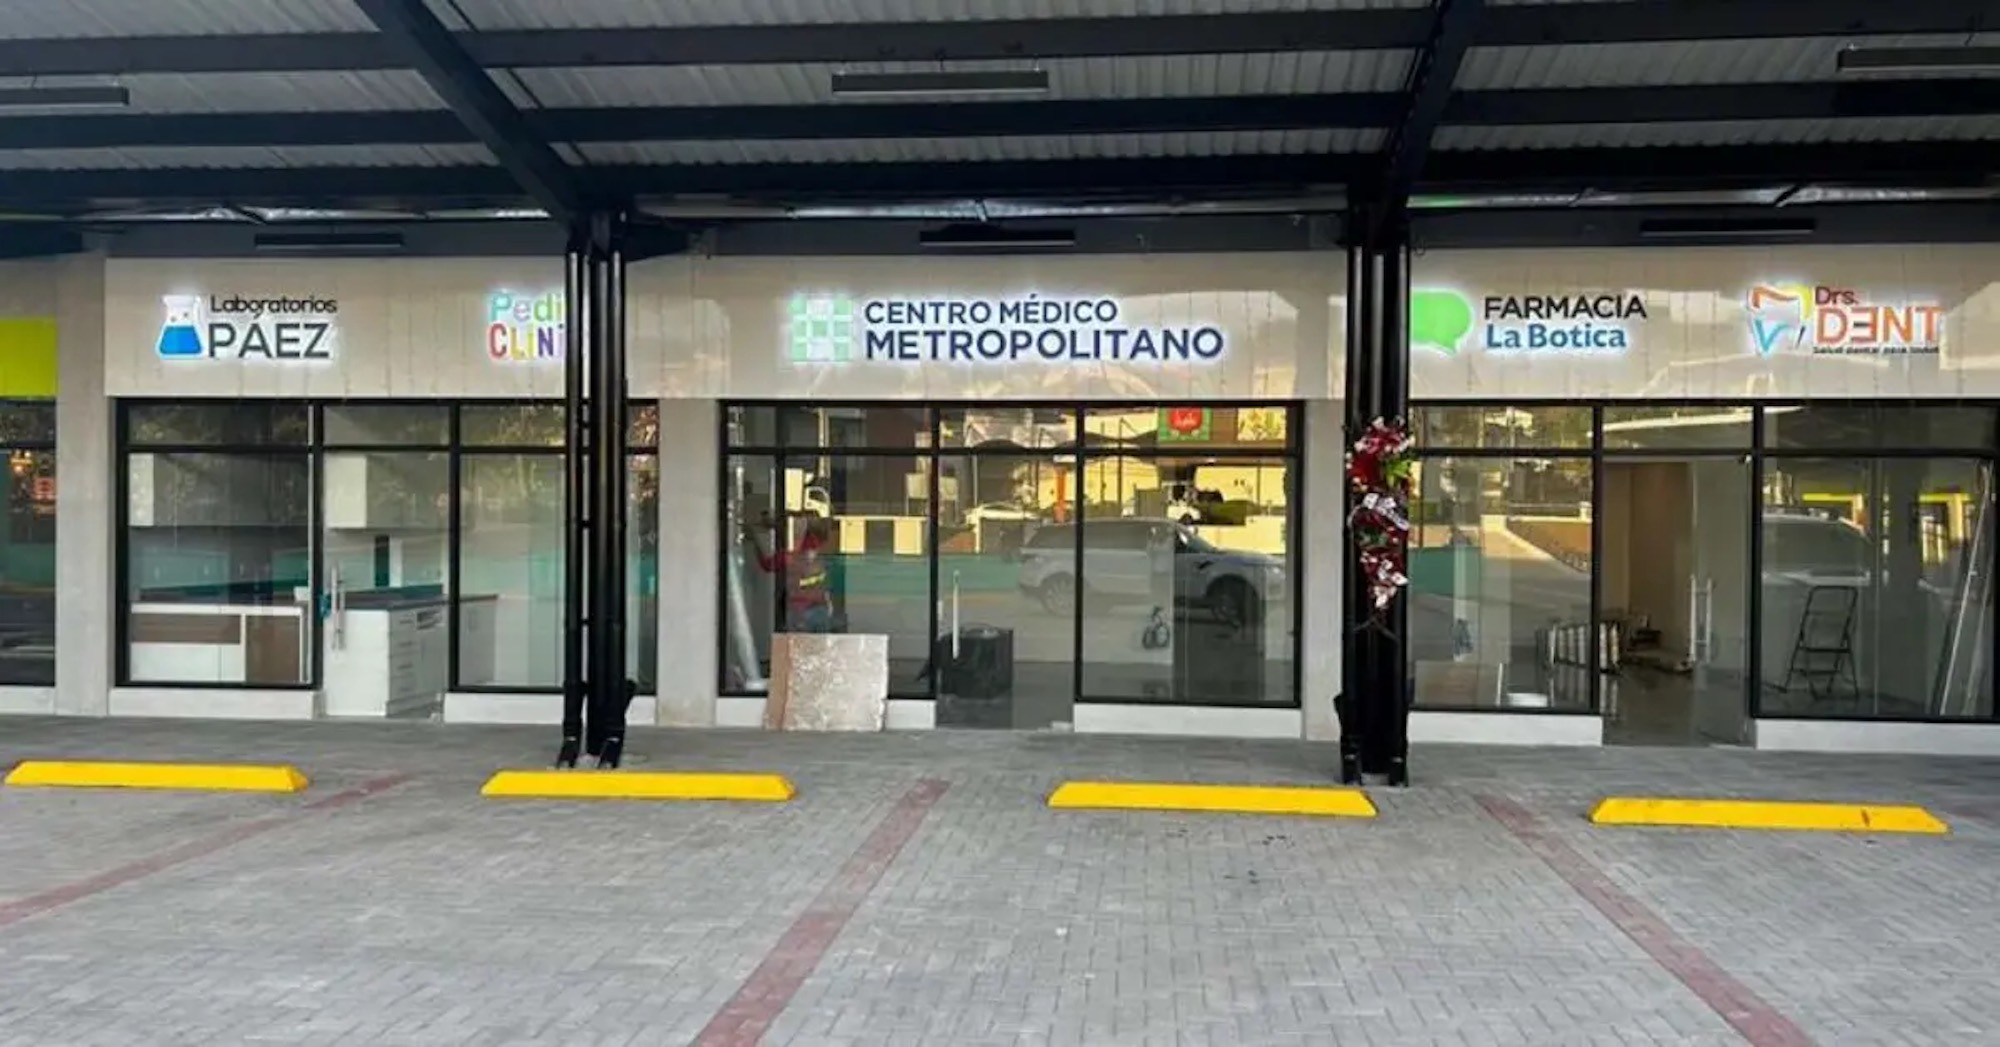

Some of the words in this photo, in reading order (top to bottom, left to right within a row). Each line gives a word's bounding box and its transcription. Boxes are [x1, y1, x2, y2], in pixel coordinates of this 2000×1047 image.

[210, 294, 337, 313] Laboratorios
[1484, 296, 1647, 319] FARMACIA
[1815, 286, 1858, 305] Drs.
[865, 301, 991, 324] CENTRO
[1000, 293, 1117, 324] MÉDICO
[208, 312, 329, 358] PÁEZ
[866, 327, 1224, 360] METROPOLITANO
[1487, 324, 1521, 348] La
[1528, 323, 1626, 348] Botica
